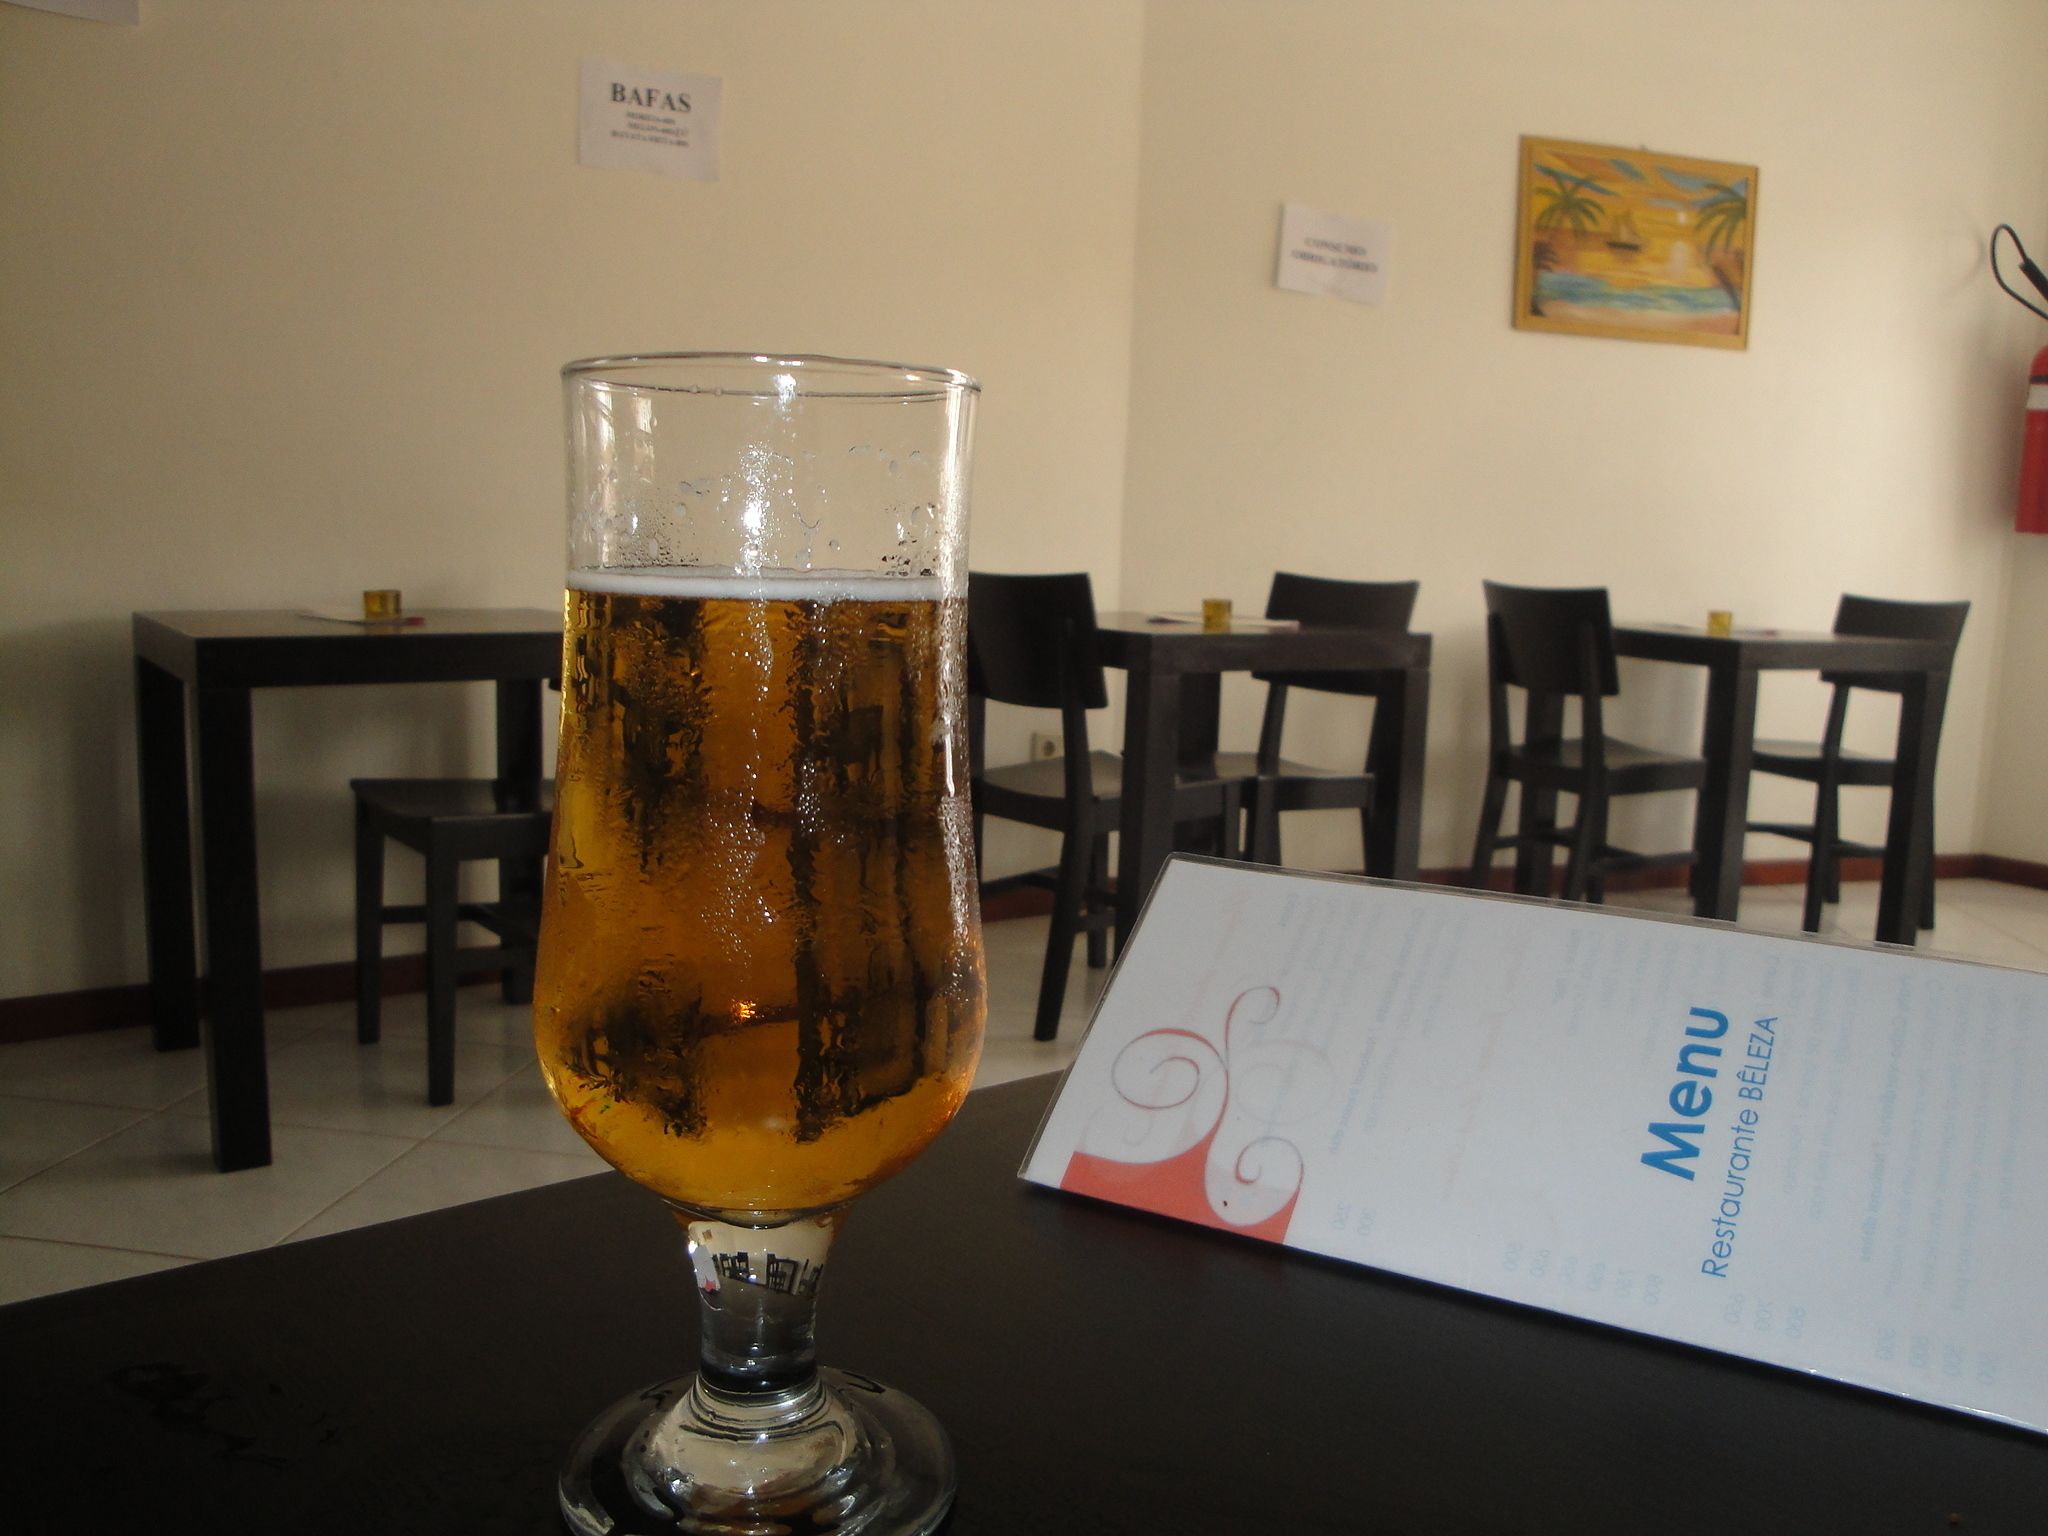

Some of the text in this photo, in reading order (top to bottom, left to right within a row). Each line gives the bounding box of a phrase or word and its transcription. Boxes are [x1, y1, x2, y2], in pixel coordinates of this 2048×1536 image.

[611, 82, 692, 113] BAFAS
[1640, 1006, 1729, 1181] Menu
[1701, 1016, 1779, 1278] Restaurante BÊLEZA
